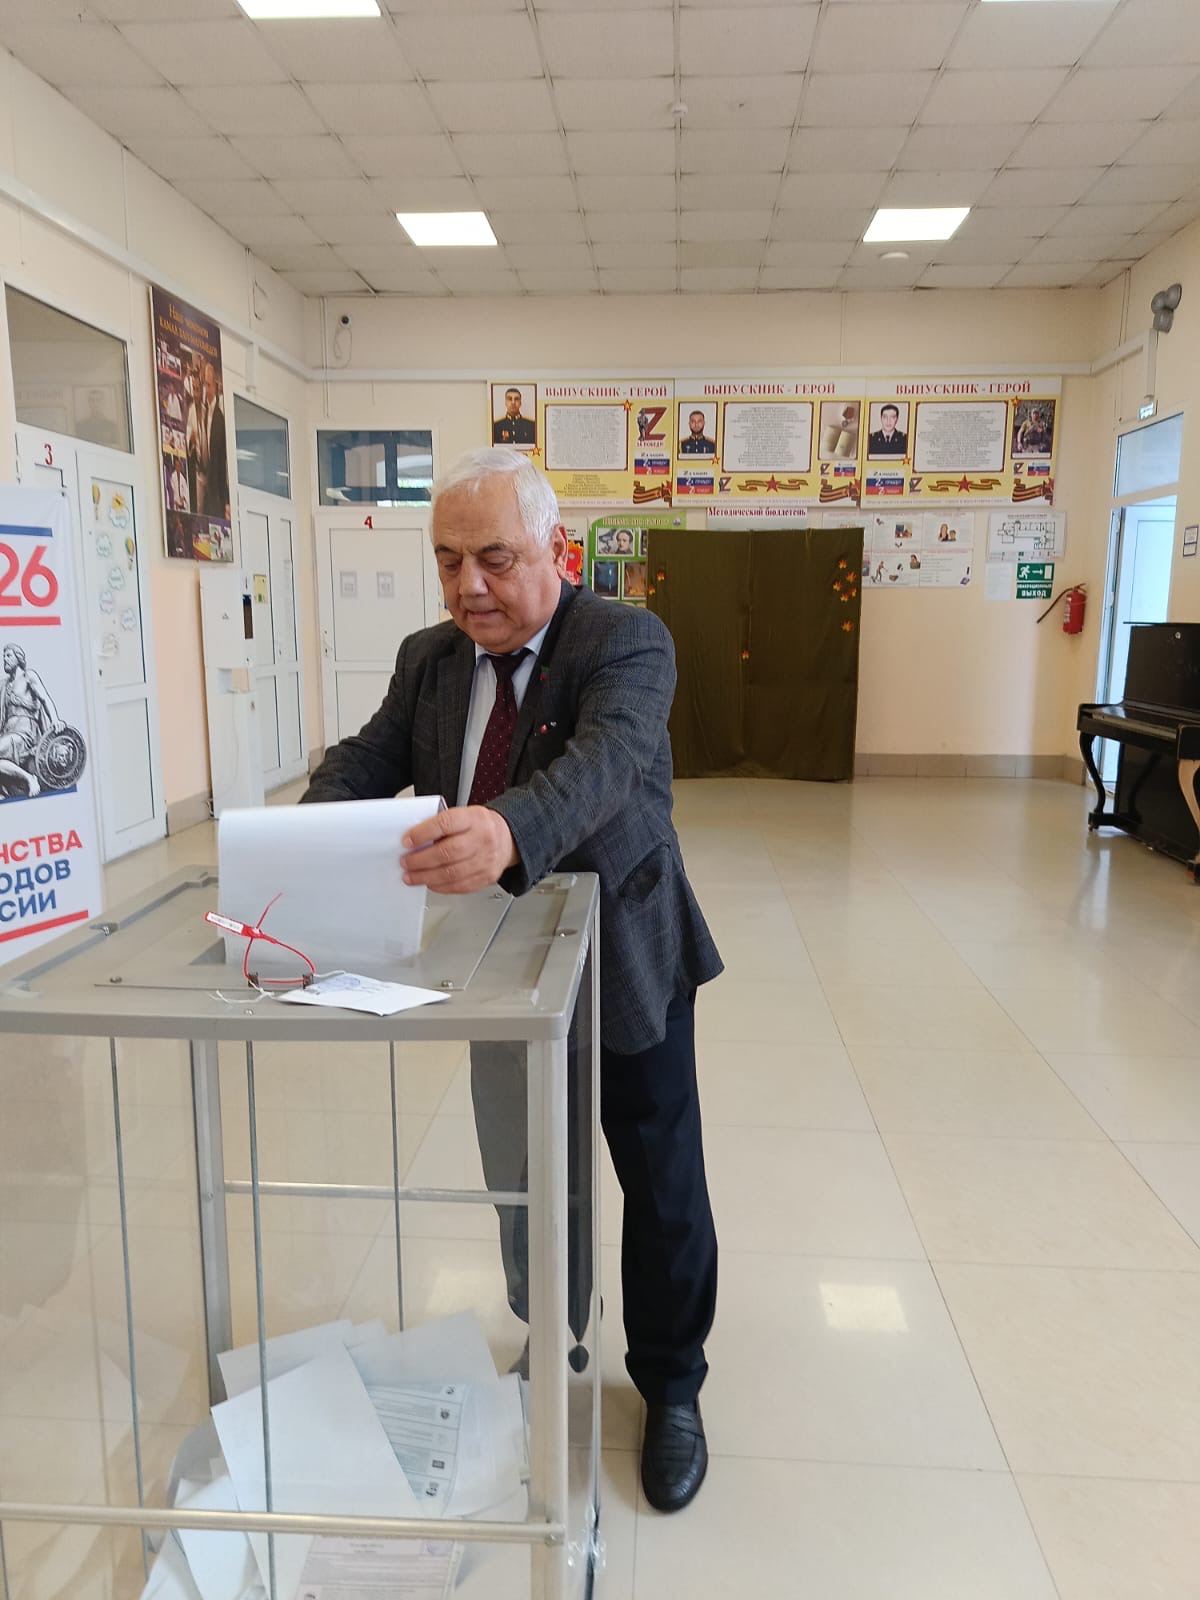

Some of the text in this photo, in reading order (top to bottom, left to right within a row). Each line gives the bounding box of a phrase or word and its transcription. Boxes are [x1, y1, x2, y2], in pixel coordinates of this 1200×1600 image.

[545, 386, 620, 397] ВЫПУСКНИК
[629, 384, 668, 397] ГЕРОЙ
[703, 383, 784, 395] ВЫПУСКНИК
[794, 381, 836, 395] ГЕРОЙ
[895, 382, 979, 395] ВЫПУСКНИК
[989, 380, 1031, 394] ГЕРОЙ
[44, 443, 53, 466] 3
[708, 506, 763, 517] Методический
[364, 515, 373, 530] 4
[1021, 590, 1047, 598] ВЫХОД
[0, 859, 71, 895] ОДОВ
[0, 888, 57, 922] СИИ
